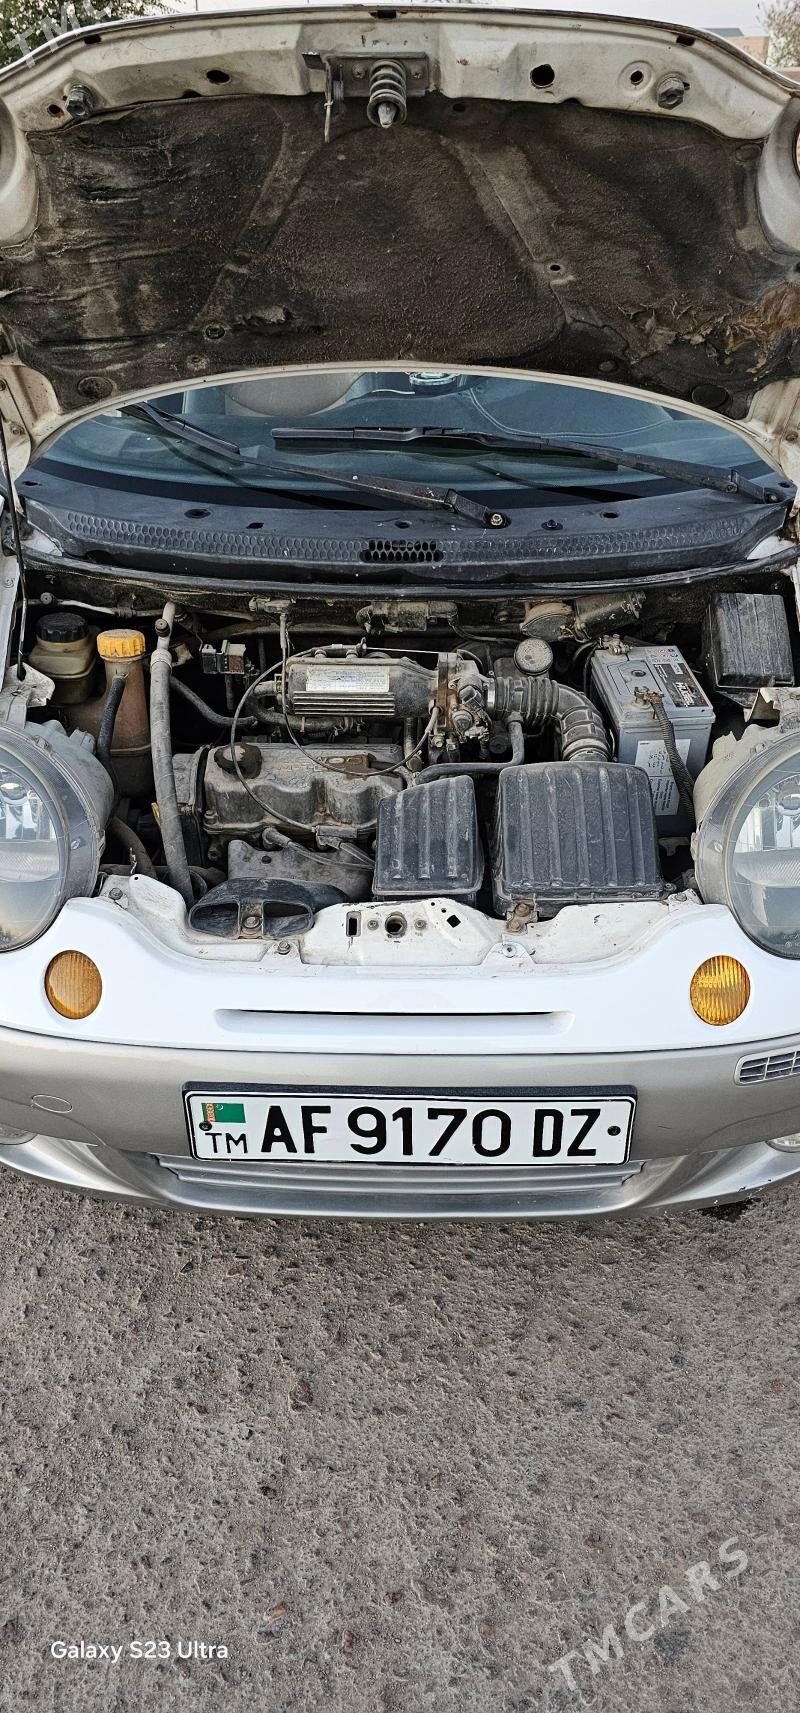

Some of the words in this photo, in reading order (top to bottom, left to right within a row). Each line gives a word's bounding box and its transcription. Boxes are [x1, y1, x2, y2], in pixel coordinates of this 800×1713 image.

[205, 1132, 249, 1154] TM
[261, 1105, 332, 1154] AF
[347, 1106, 512, 1157] 9170
[532, 1107, 602, 1157] DZ
